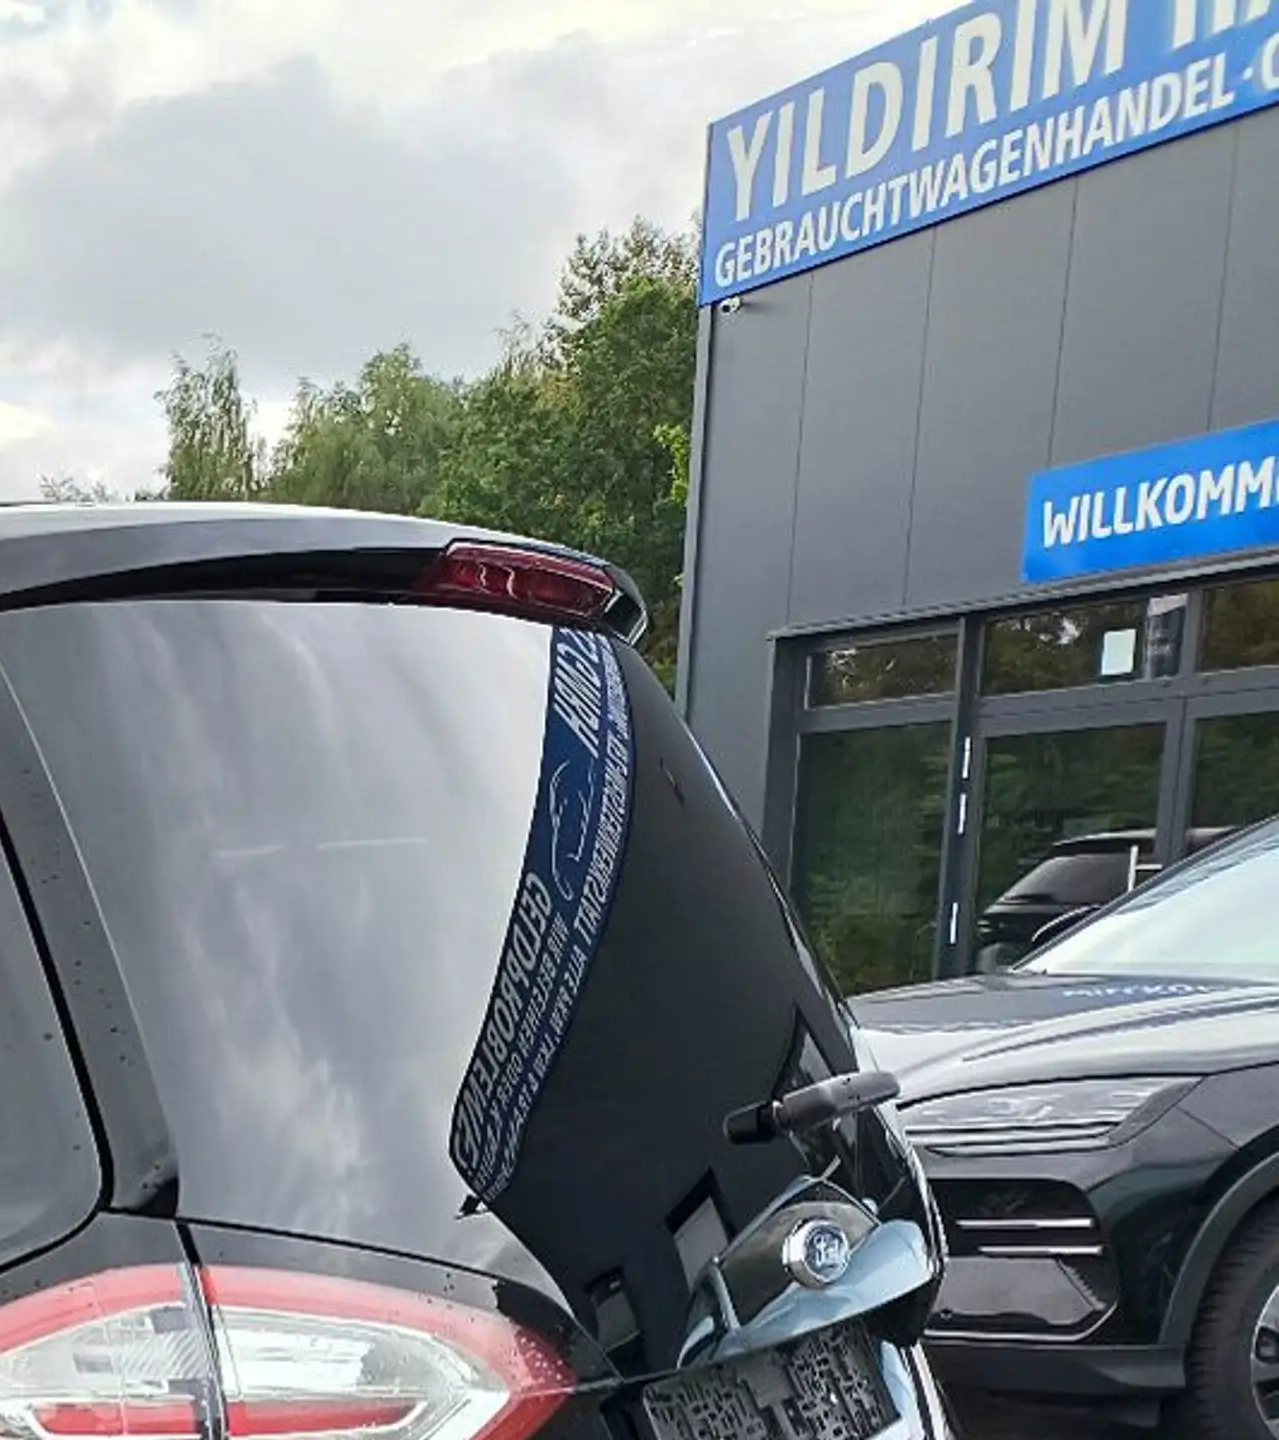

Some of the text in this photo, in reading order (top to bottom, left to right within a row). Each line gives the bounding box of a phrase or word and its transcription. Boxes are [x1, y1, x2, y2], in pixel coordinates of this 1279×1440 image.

[714, 52, 1236, 288] GEBRAUCHTWAGENHANDEL
[727, 0, 1129, 223] YILDIRIM
[1043, 455, 1279, 549] WILLKOMM
